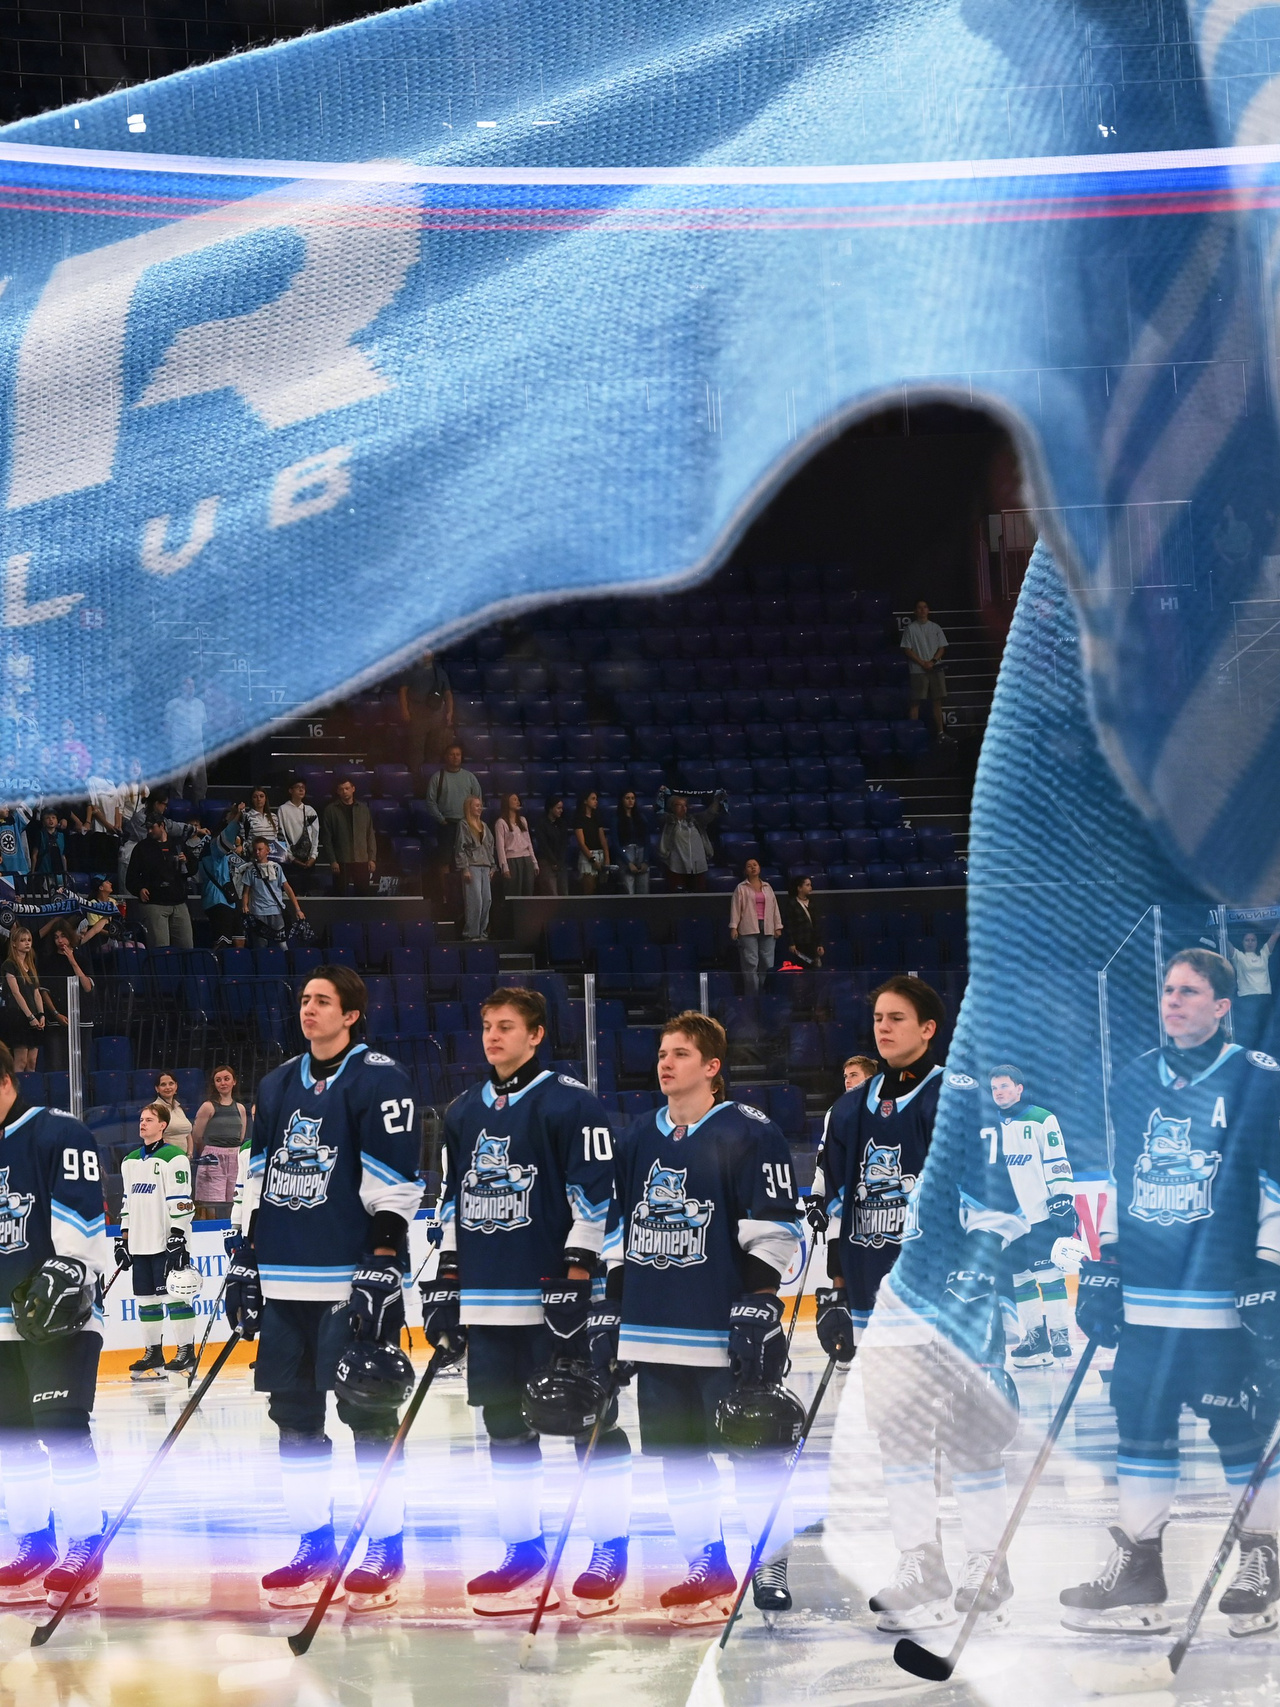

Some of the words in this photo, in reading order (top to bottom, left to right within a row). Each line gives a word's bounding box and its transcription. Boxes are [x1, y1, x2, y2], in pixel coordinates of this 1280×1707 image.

[307, 723, 324, 737] 16
[380, 1097, 415, 1135] 27
[582, 1126, 614, 1162] 10
[62, 1147, 100, 1182] 98
[761, 1162, 794, 1200] 34
[32, 1389, 69, 1404] CCM
